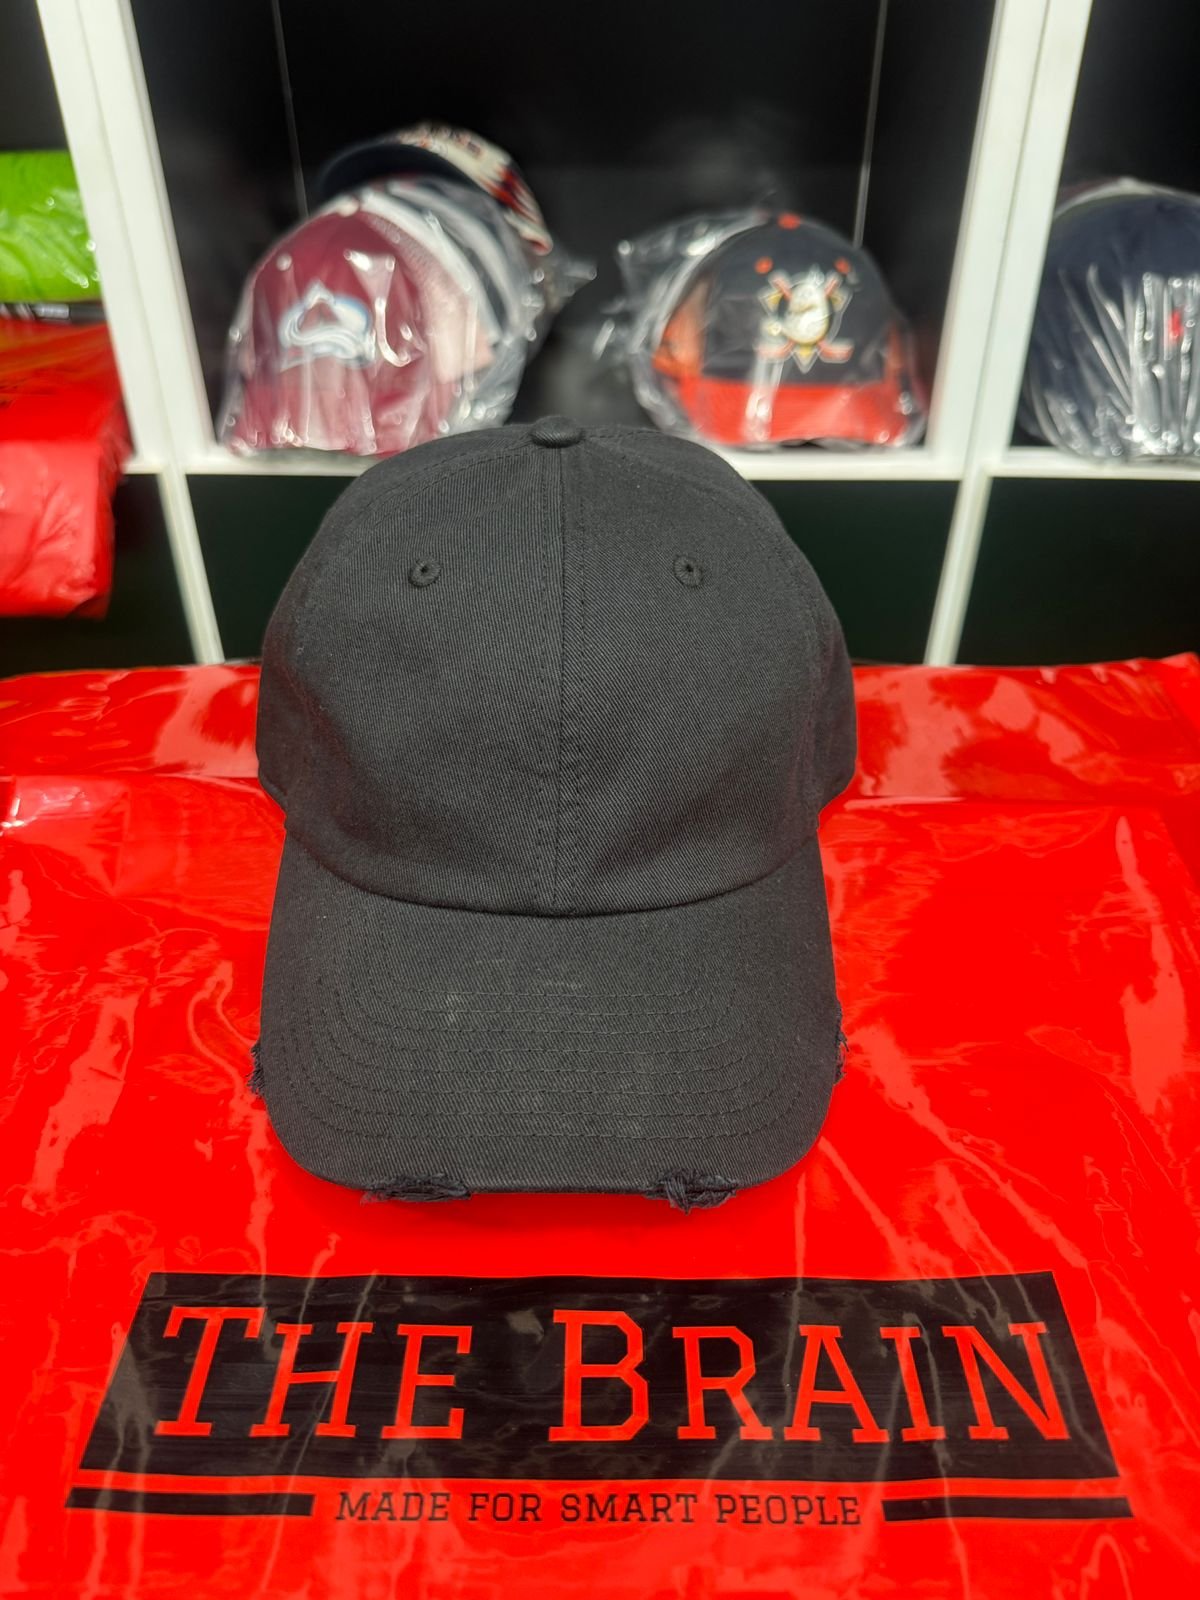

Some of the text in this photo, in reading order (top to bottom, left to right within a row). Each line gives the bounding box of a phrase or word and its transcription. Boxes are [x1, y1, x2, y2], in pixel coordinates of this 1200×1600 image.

[154, 1306, 1070, 1443] THE BRAIN
[336, 1492, 861, 1525] MADE FOR SMART PEOPLE
